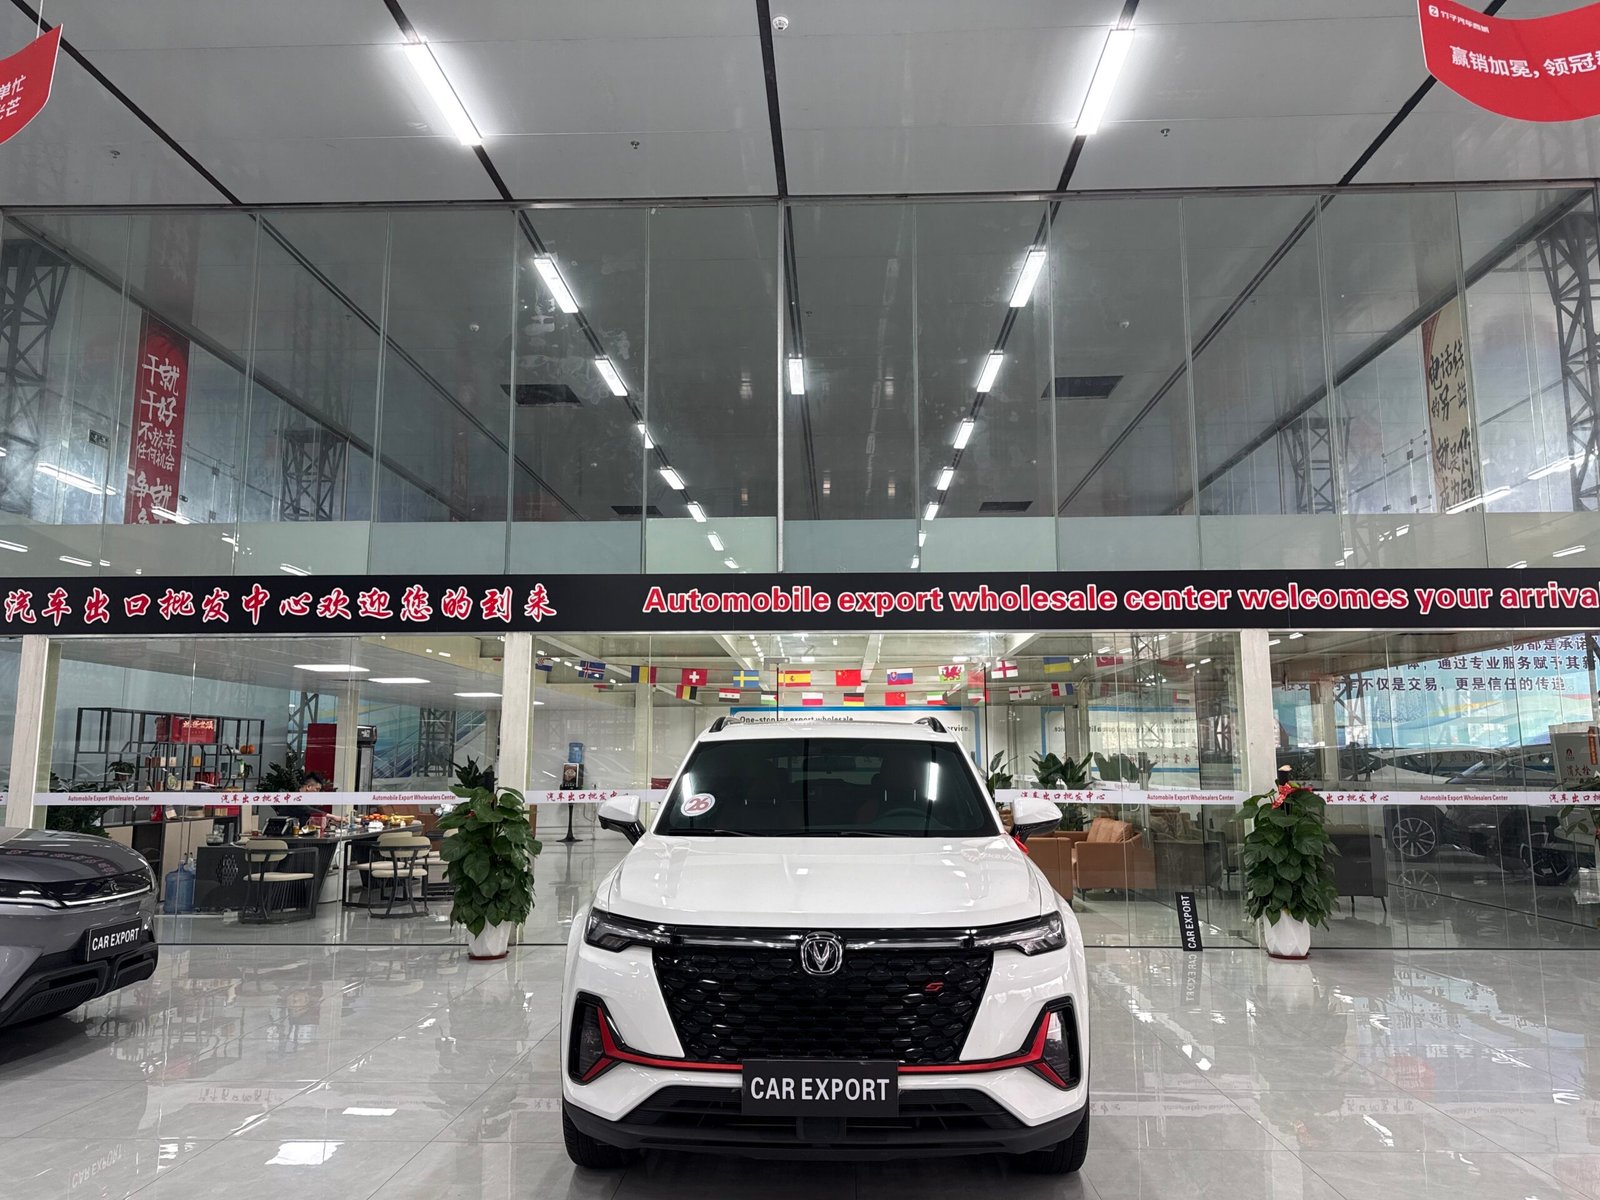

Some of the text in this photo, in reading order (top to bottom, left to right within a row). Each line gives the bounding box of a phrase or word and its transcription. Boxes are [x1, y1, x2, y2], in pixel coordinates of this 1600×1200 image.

[1450, 45, 1600, 79] 赢销加冕，领冠
[4, 583, 557, 627] 汽车出口批发中心欢迎您的到来
[642, 581, 1600, 618] Automobile export wholesale center welcomes your arriva
[546, 790, 629, 802] 汽车出口批发中
[688, 797, 710, 811] 26
[1180, 895, 1197, 949] CAR EXPORT
[92, 927, 140, 951] CAR EXPORT
[750, 1077, 890, 1101] CAR EXPORT
